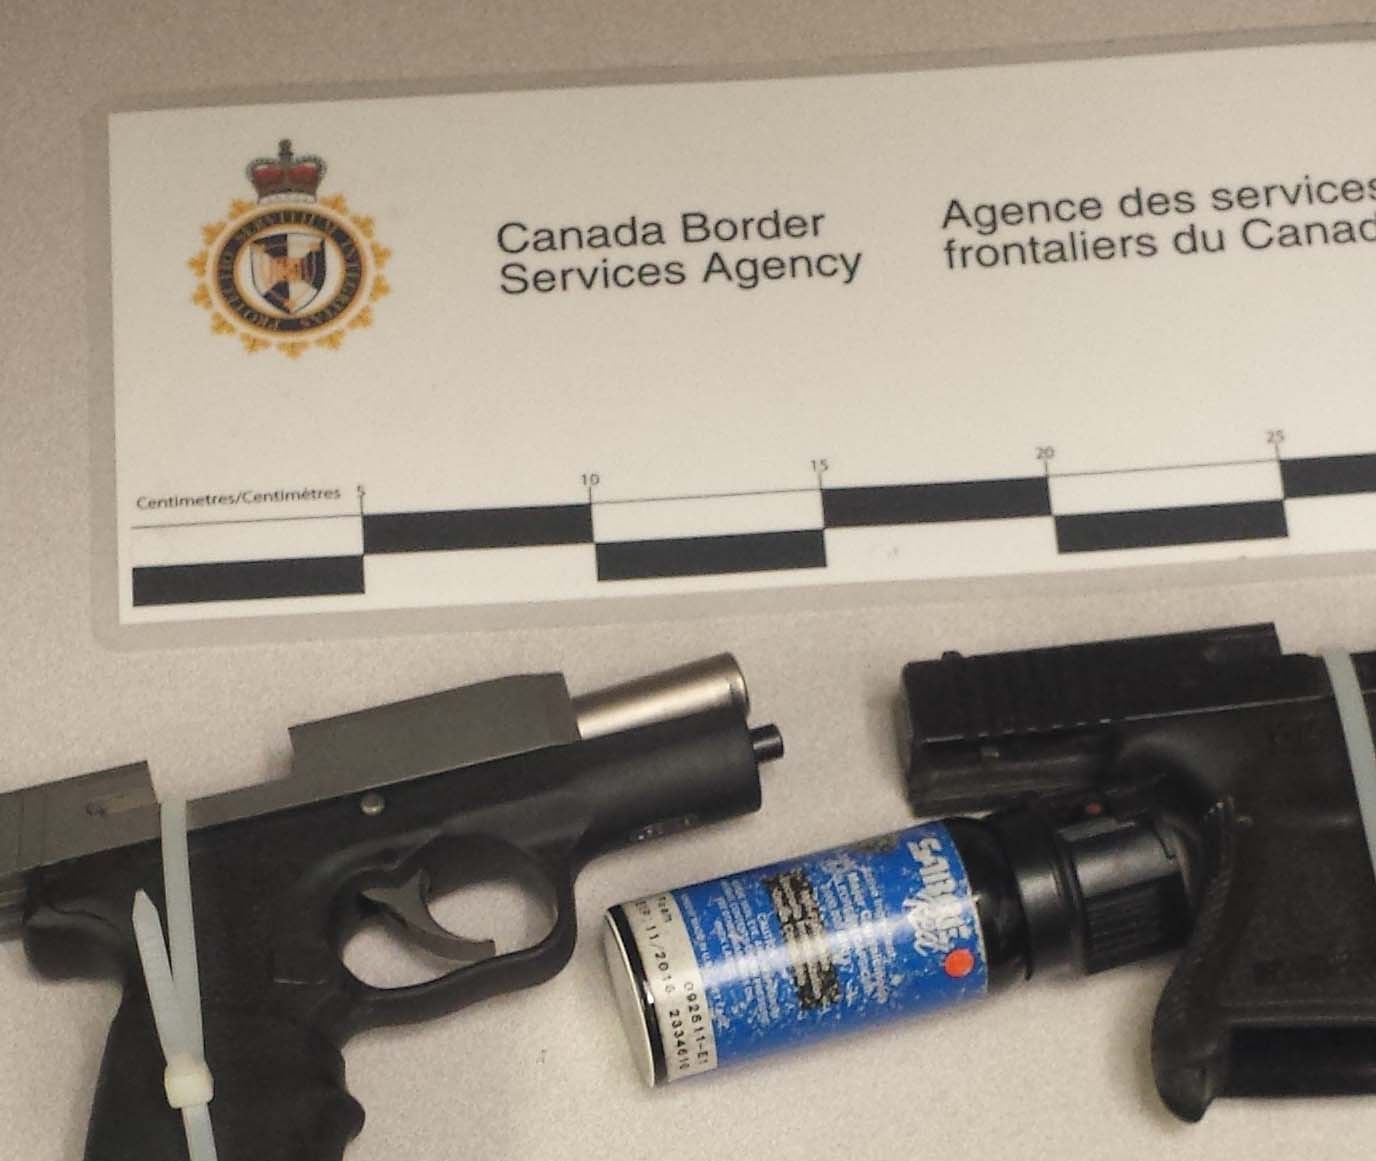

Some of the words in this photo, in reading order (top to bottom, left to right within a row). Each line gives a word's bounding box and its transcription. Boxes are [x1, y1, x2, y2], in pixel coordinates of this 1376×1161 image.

[497, 215, 666, 254] Canada
[681, 209, 825, 243] Border
[942, 197, 1102, 237] Agence
[1119, 187, 1196, 218] des
[943, 228, 1158, 270] frontaliers
[1173, 223, 1225, 255] du
[500, 251, 686, 295] Services
[703, 251, 862, 290] Agency
[356, 485, 366, 498] 5
[582, 473, 600, 486] 10
[811, 459, 829, 471] 15
[1036, 446, 1055, 460] 20
[1267, 429, 1285, 444] 25
